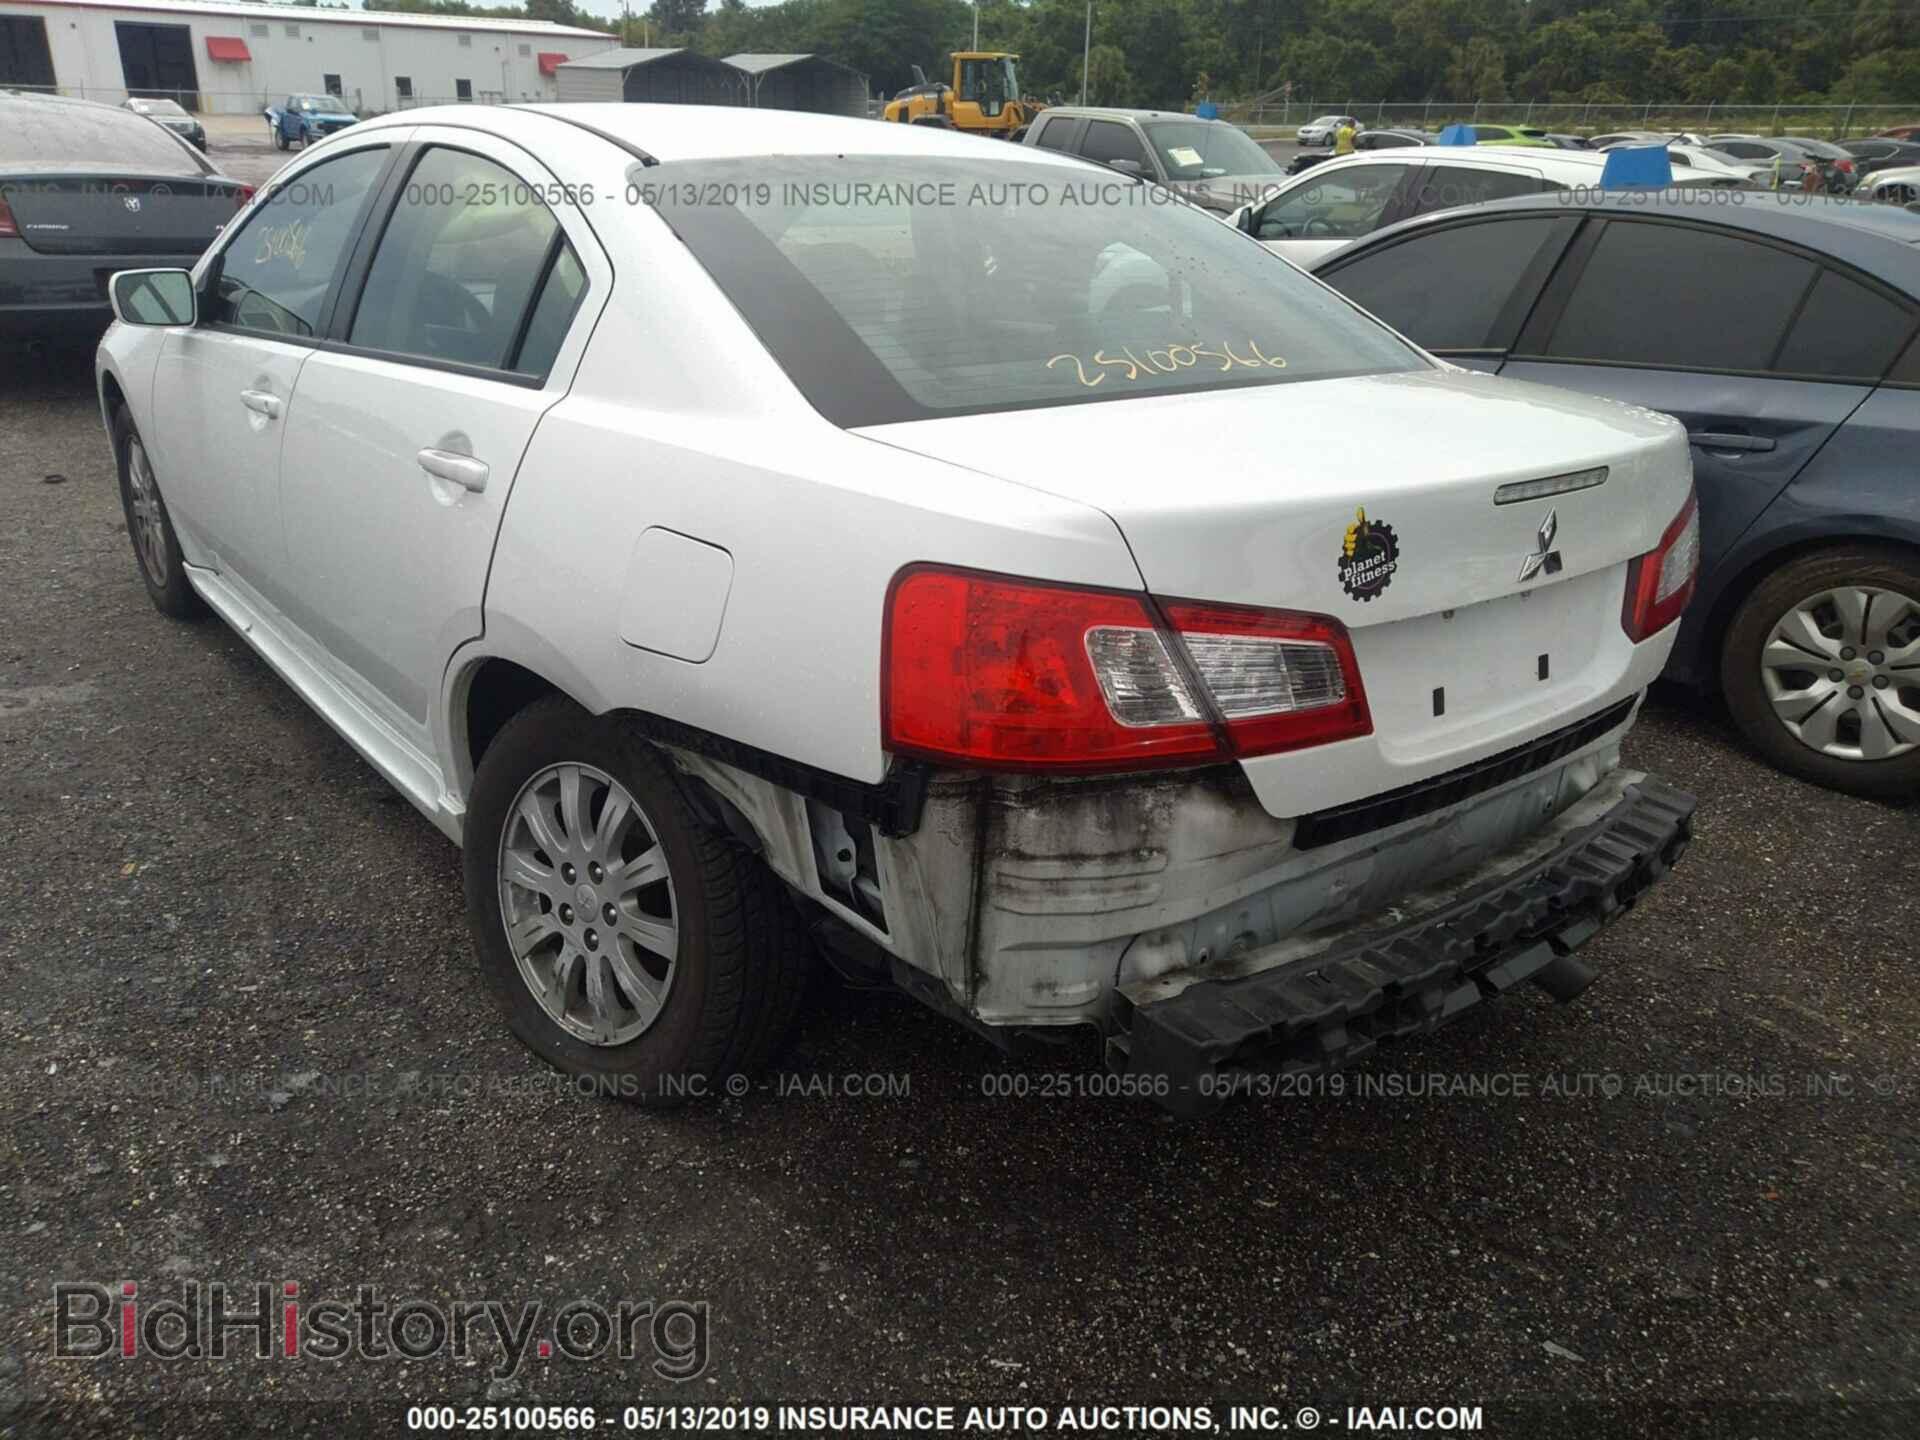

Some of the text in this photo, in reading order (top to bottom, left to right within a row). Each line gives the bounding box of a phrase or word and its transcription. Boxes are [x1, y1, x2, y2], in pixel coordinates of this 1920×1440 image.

[1047, 340, 1287, 386] 25100566
[1343, 551, 1386, 581] planet
[1351, 561, 1395, 588] fitness
